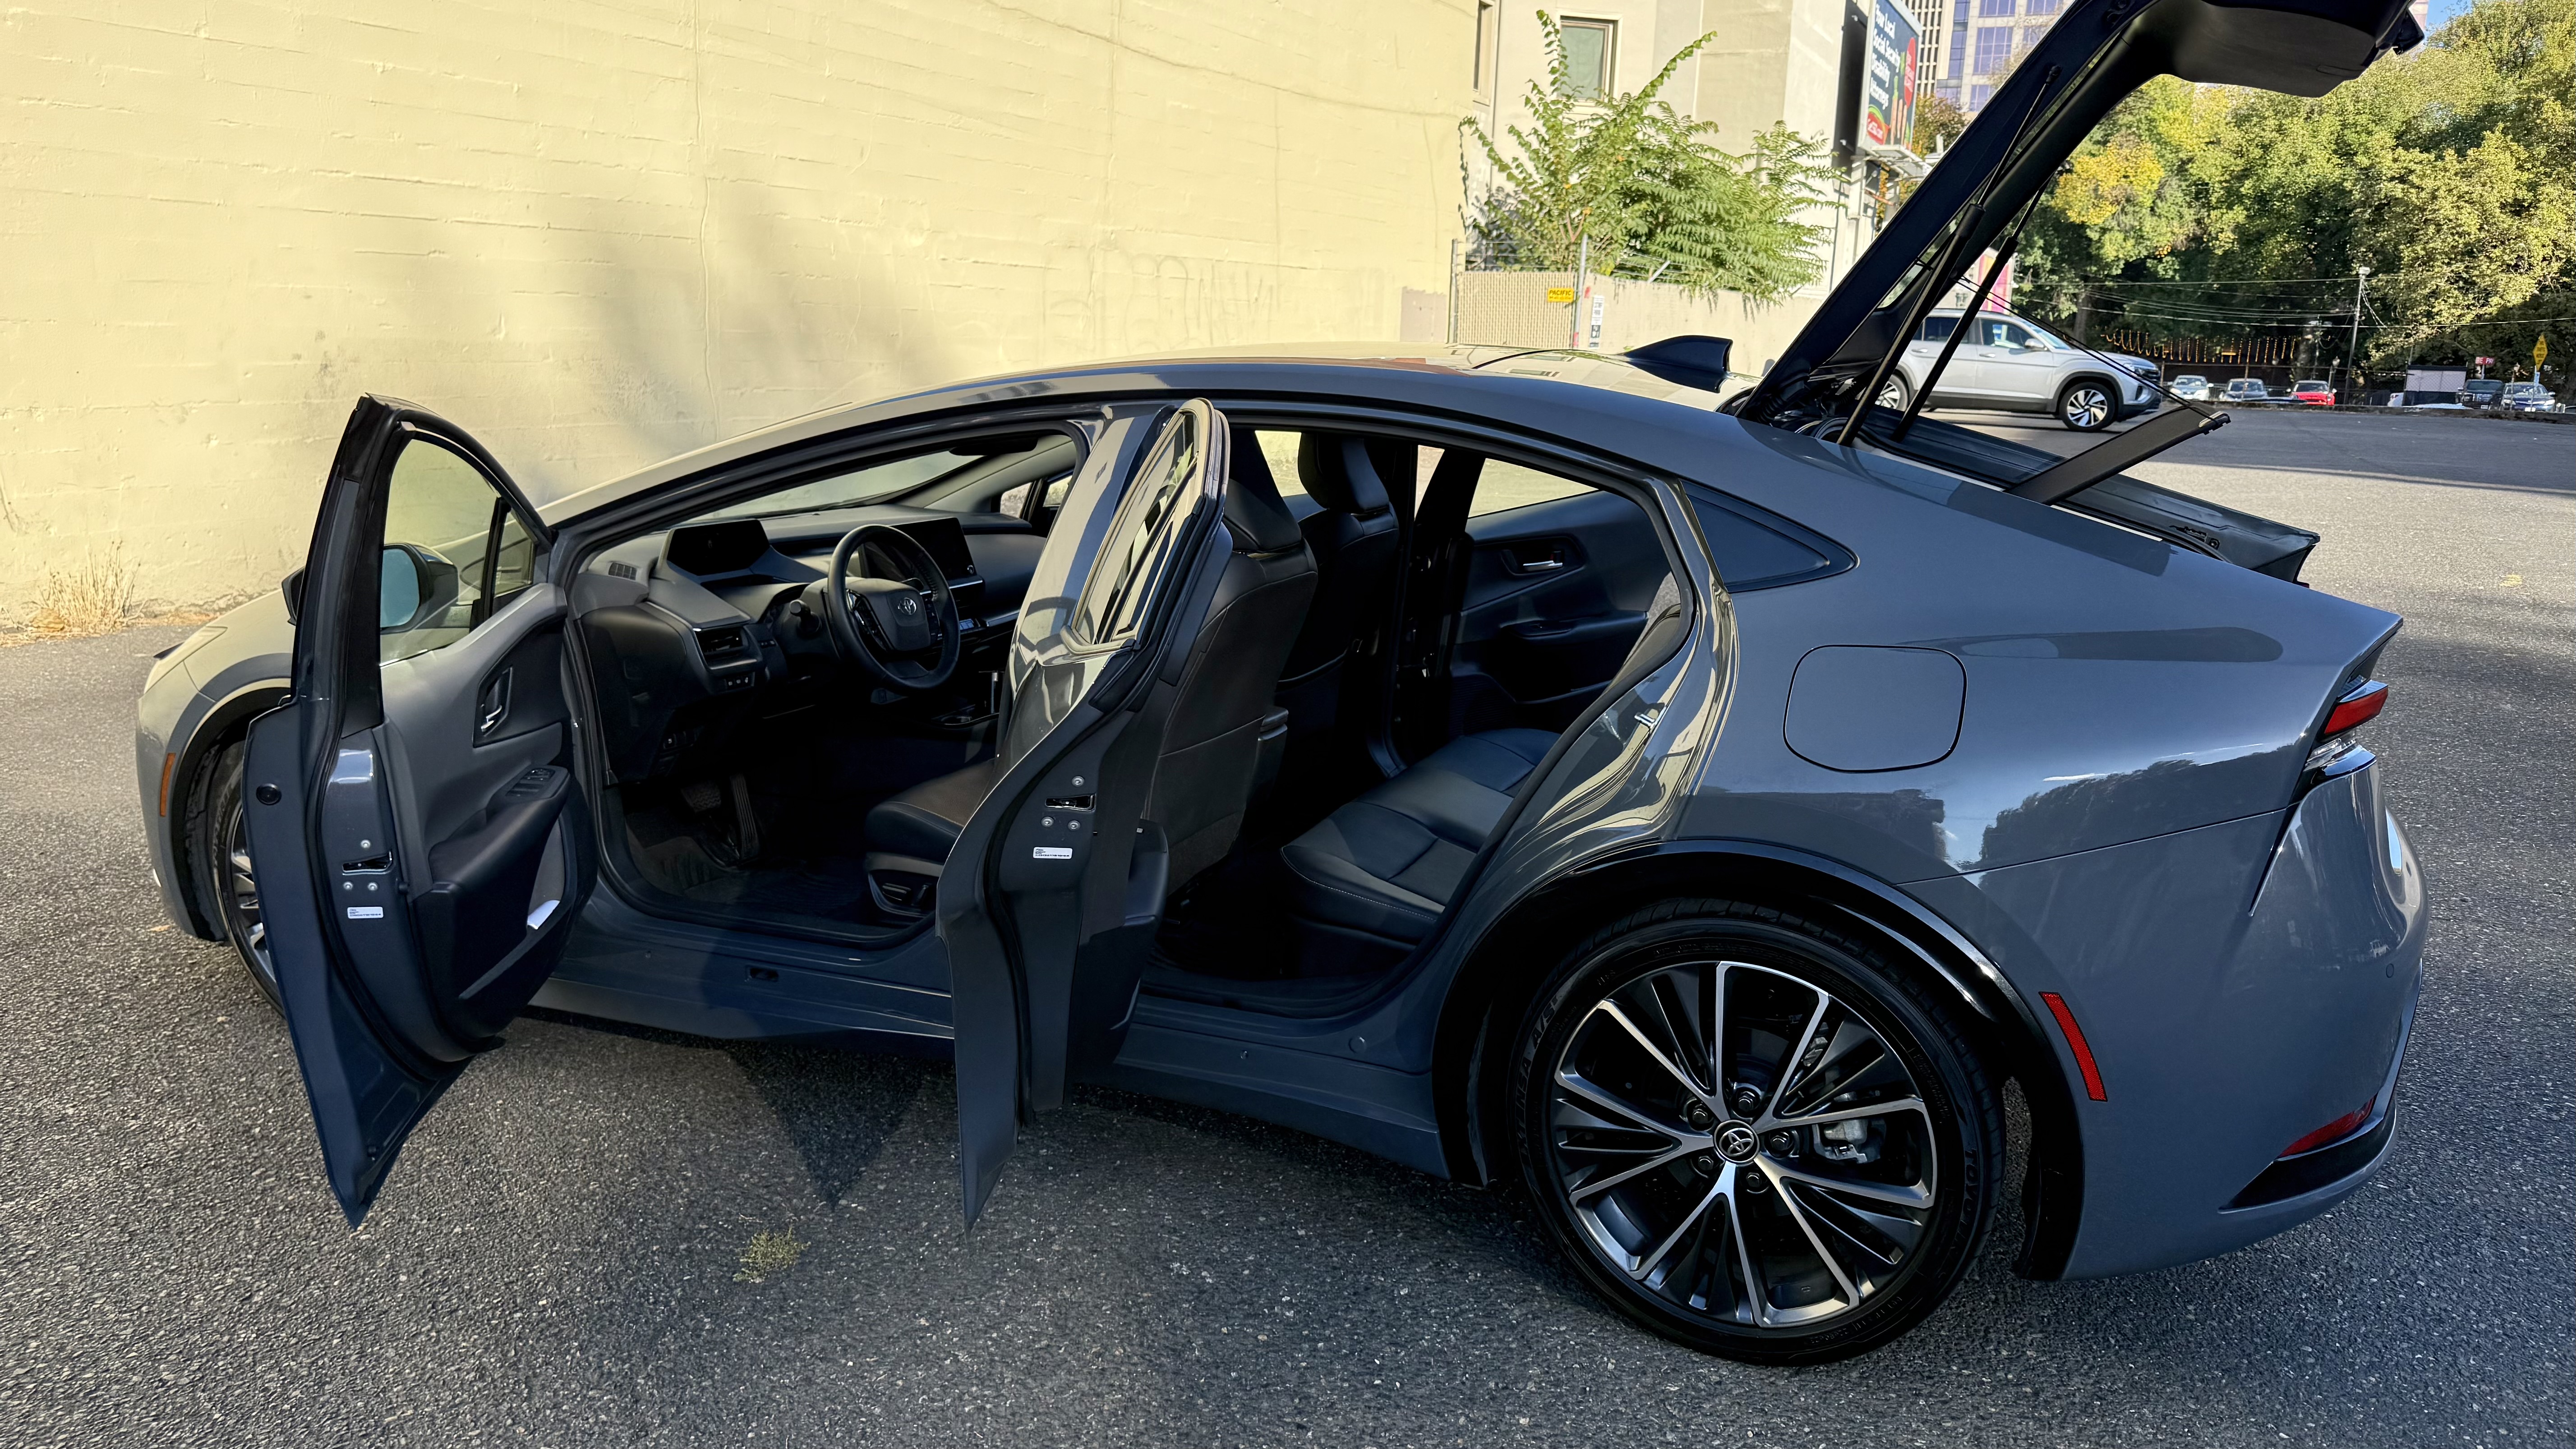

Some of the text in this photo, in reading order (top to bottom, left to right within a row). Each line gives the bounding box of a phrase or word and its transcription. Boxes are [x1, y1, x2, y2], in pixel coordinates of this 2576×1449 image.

[1884, 13, 1896, 39] Local
[1873, 28, 1900, 73] Social Security
[1963, 1148, 1978, 1216] TOYO
